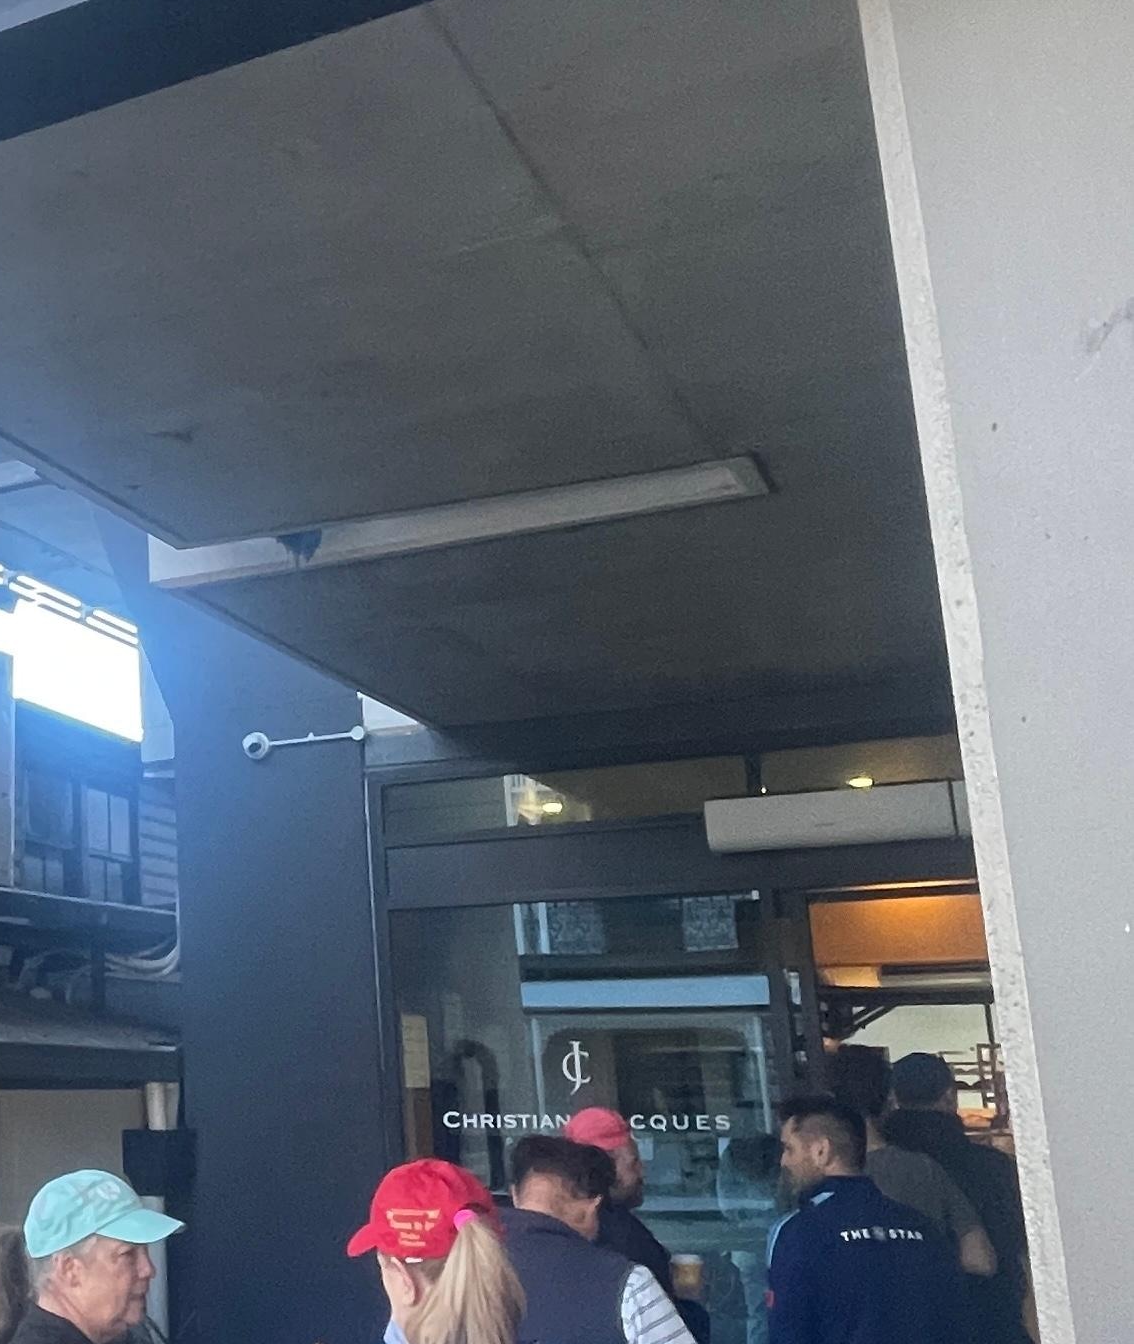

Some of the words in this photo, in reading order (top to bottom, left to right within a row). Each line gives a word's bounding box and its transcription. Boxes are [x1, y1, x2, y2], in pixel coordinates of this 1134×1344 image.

[629, 1114, 731, 1131] CQUES
[840, 1228, 870, 1242] THE
[888, 1228, 924, 1241] STAR
